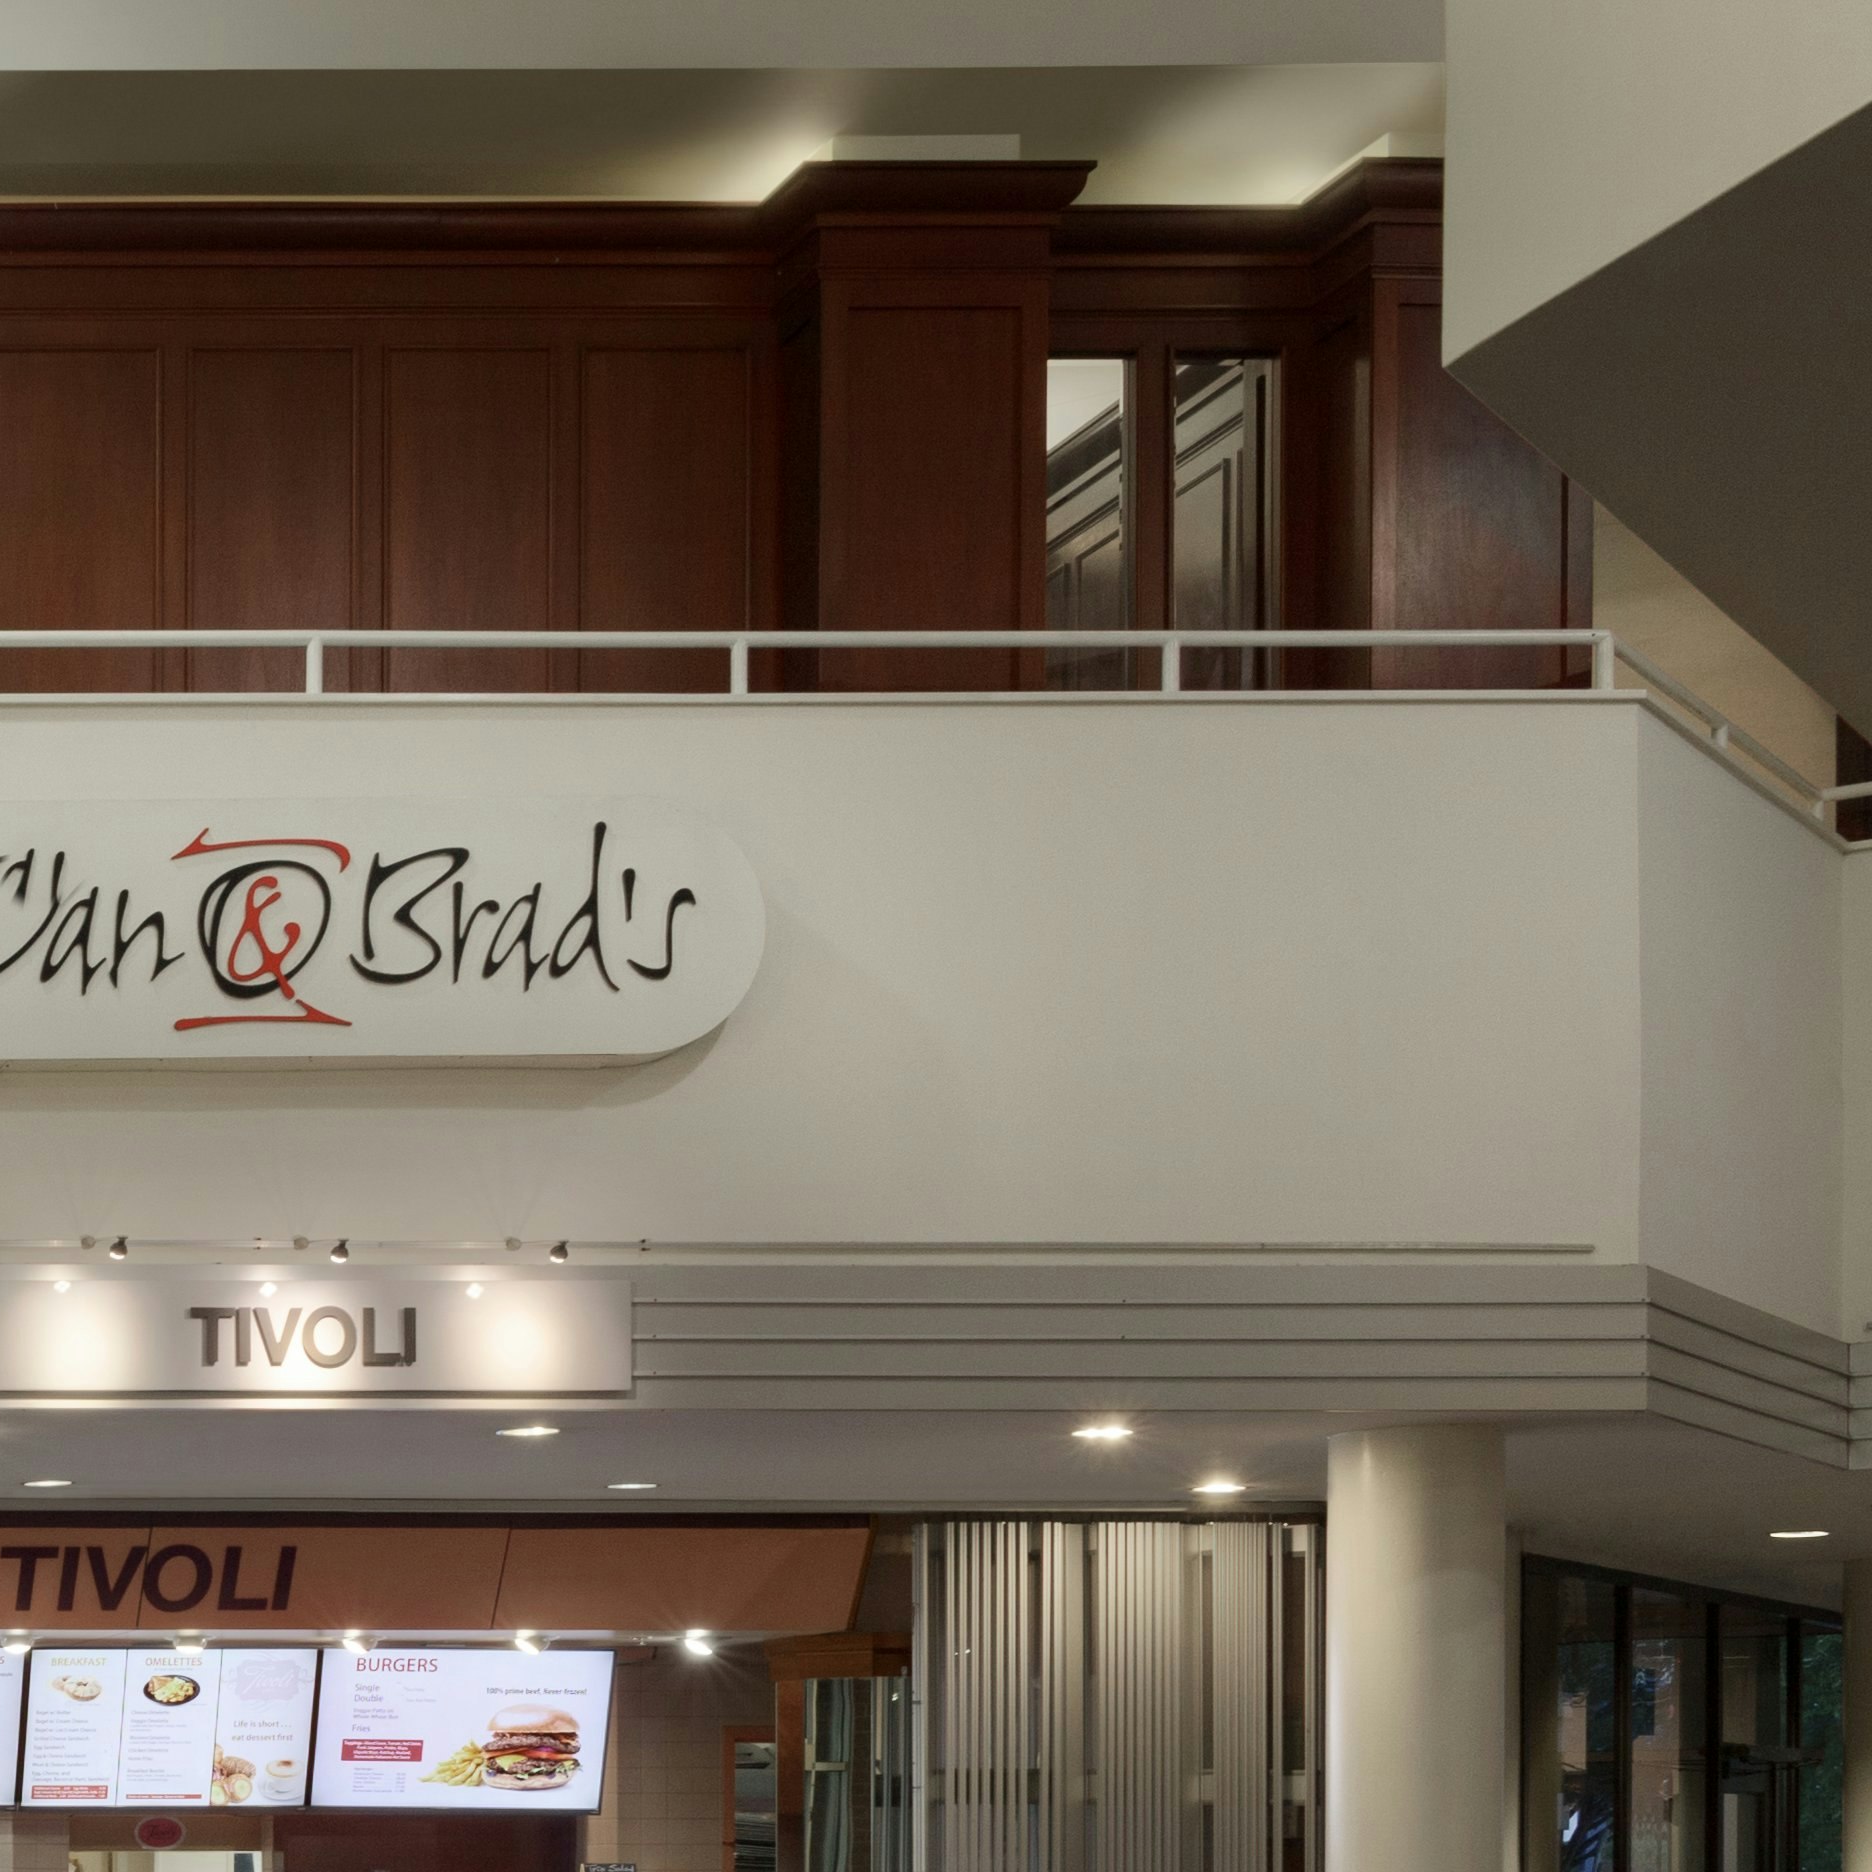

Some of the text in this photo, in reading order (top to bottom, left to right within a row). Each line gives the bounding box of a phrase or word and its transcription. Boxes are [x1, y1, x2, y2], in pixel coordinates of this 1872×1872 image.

[350, 821, 695, 993] Brad's
[189, 1306, 417, 1368] TIVOLI
[0, 1544, 297, 1613] TIVOLI
[51, 1657, 106, 1667] BREAKFAST
[145, 1657, 202, 1667] OMELETTES
[356, 1657, 438, 1673] BURGERS
[354, 1683, 380, 1692] Single
[354, 1694, 384, 1702] Double
[233, 1720, 280, 1728] Life is short
[352, 1723, 371, 1732] Fries
[231, 1733, 293, 1741] eat dessert first
